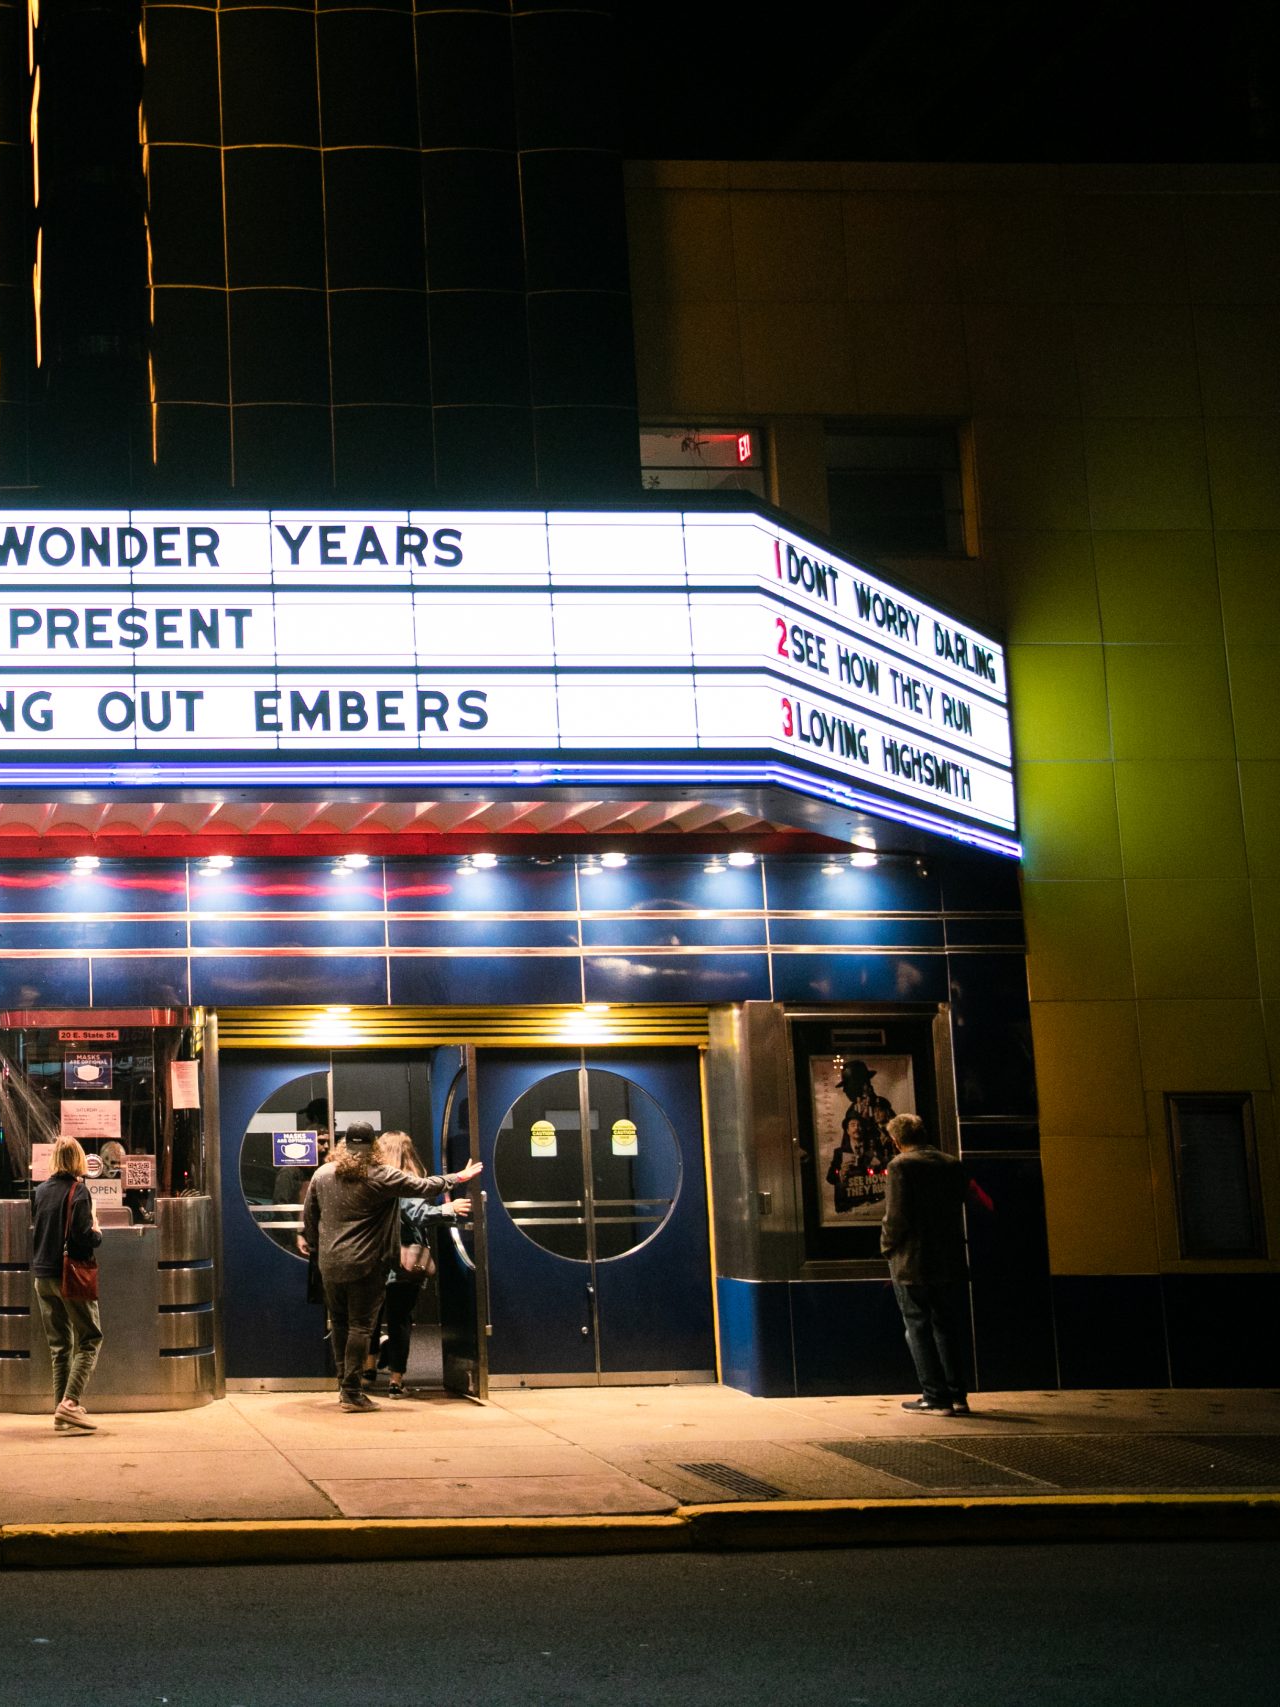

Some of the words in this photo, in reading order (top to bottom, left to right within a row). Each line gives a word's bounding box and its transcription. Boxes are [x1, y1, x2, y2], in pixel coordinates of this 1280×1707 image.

[275, 525, 463, 567] YEARS
[10, 608, 253, 649] PRESENT
[774, 540, 782, 579] 1
[786, 544, 838, 606] DONT
[854, 580, 920, 646] WORRY
[933, 620, 996, 684] DARLING
[776, 617, 789, 659] 2
[790, 628, 829, 675] SEE
[837, 644, 879, 696] HOW
[890, 668, 934, 719] THEY
[940, 692, 972, 737] RUN
[98, 690, 204, 734] OUT
[254, 690, 489, 733] EMBERS
[782, 698, 793, 737] 3
[797, 702, 870, 764] LOVING
[881, 735, 972, 802] HIGHSMITH
[90, 1186, 118, 1194] OPEN
[846, 1185, 870, 1197] THEY
[848, 1176, 864, 1187] SEE
